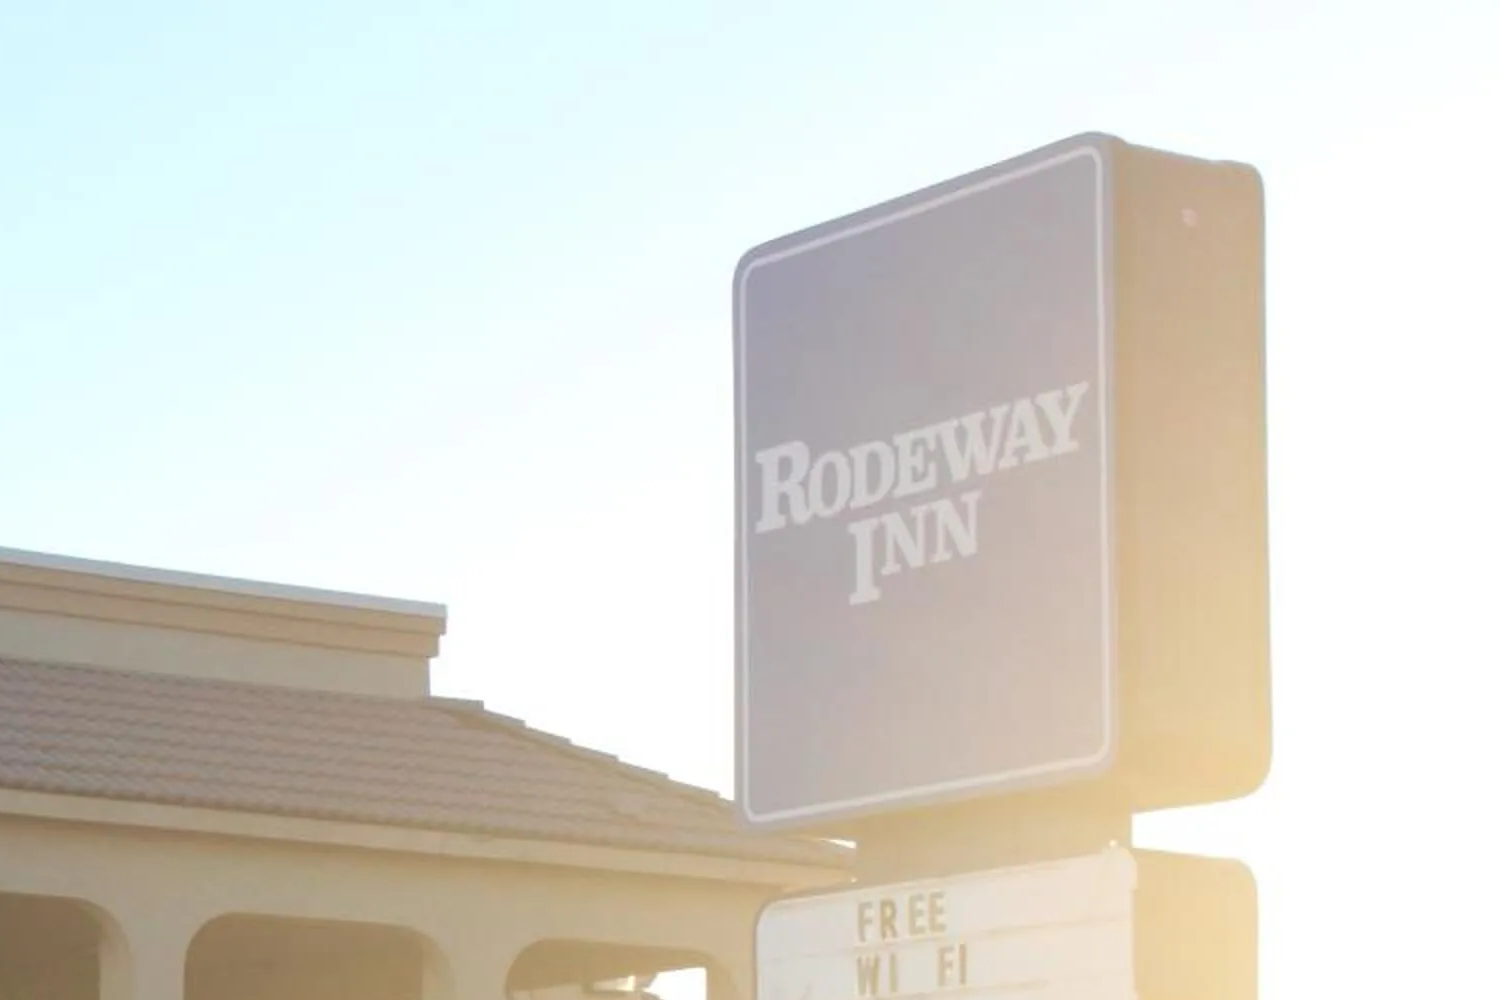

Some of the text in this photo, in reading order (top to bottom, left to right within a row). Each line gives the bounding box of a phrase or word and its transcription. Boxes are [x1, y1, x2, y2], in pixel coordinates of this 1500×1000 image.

[754, 381, 1090, 534] RODEWAY
[848, 492, 982, 606] INN
[856, 891, 947, 943] FREE
[856, 943, 968, 997] WI FI
